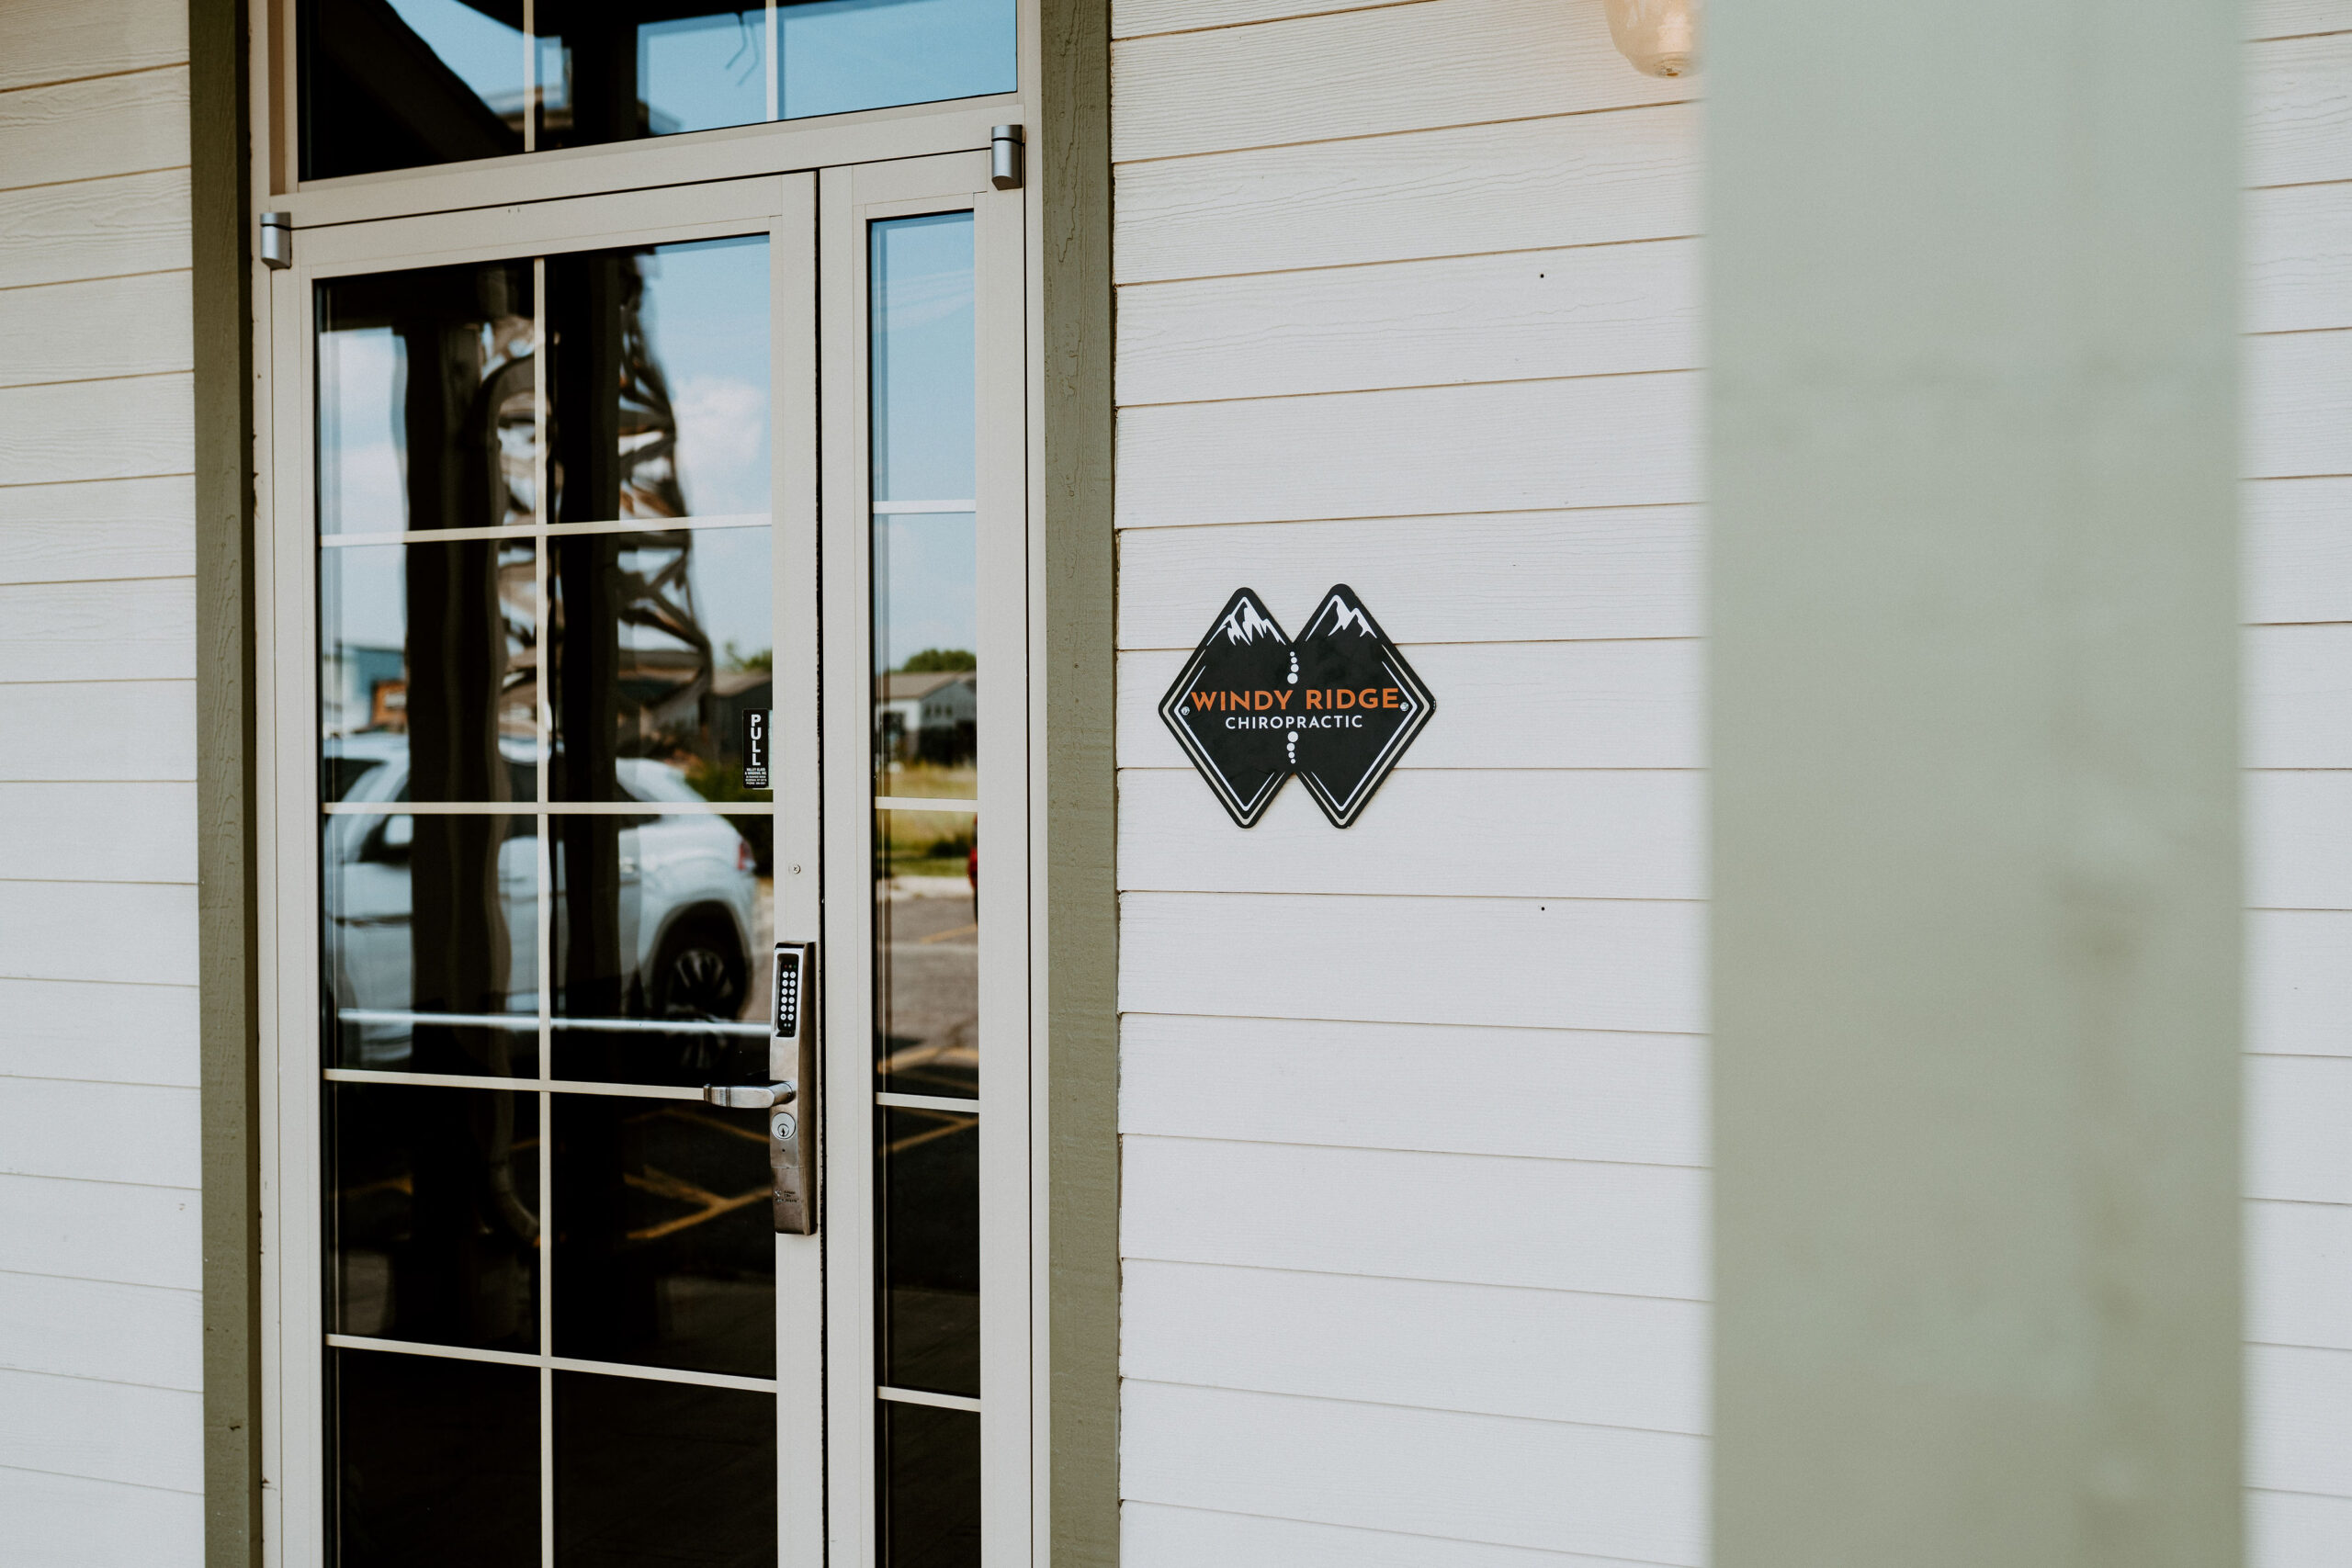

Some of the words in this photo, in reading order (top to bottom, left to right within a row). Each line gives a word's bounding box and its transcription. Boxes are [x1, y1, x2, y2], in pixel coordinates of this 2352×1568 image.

[1191, 689, 1294, 712] WINDY
[1306, 687, 1399, 710] RIDGE
[1225, 715, 1363, 729] CHIROPRACTIC
[750, 714, 762, 766] PULL
